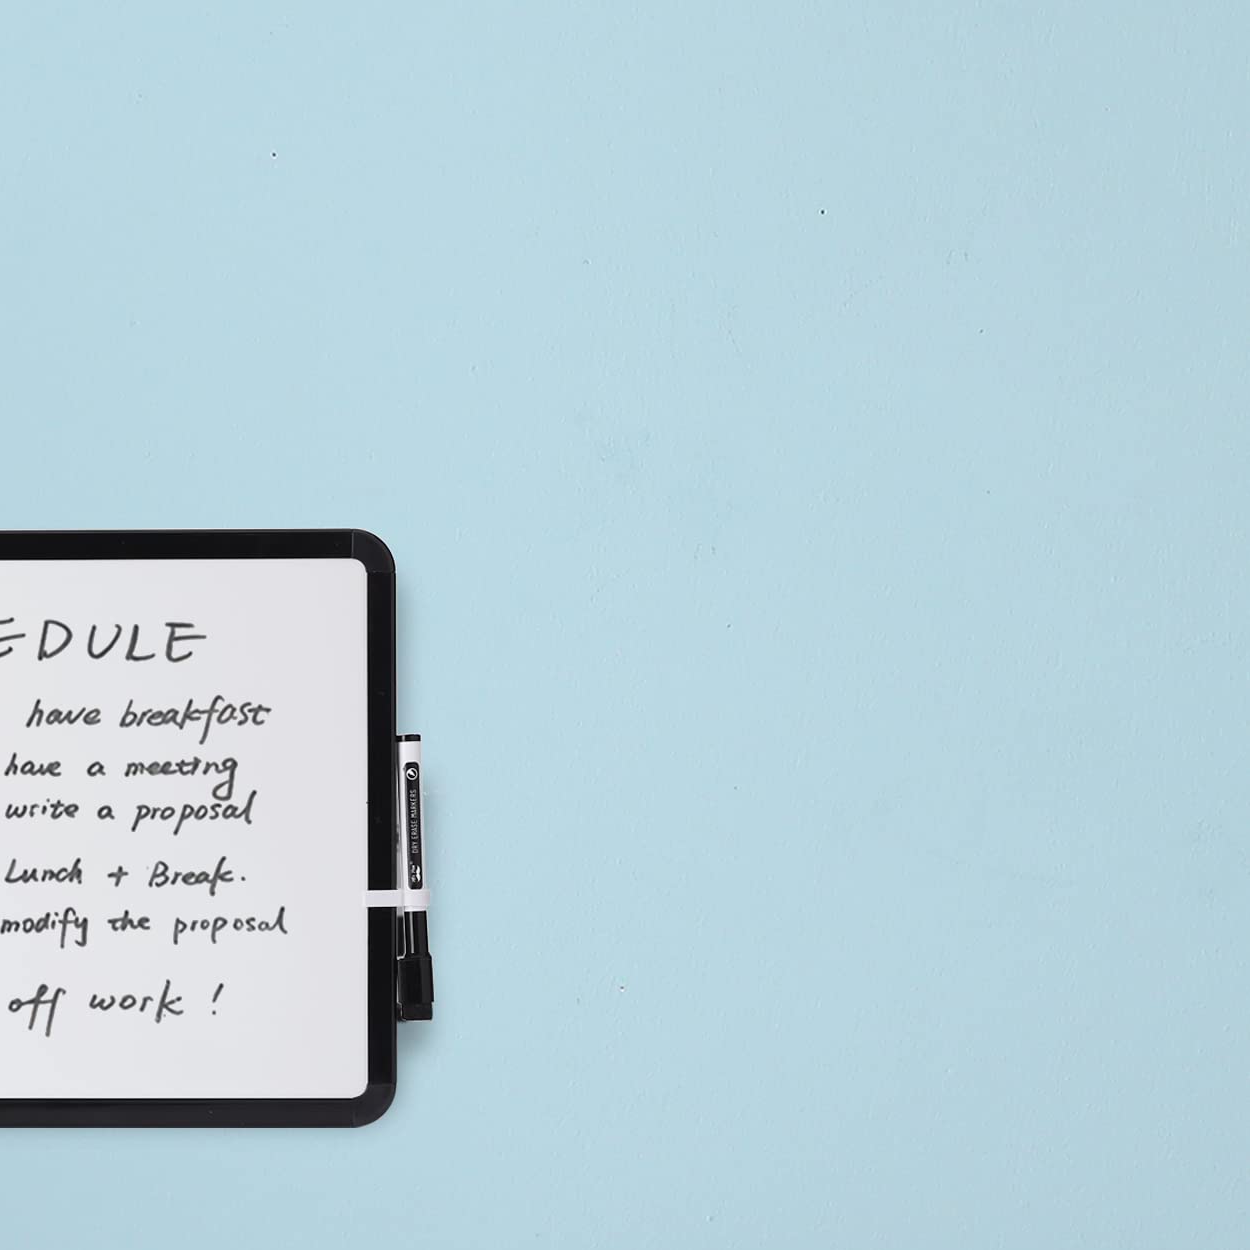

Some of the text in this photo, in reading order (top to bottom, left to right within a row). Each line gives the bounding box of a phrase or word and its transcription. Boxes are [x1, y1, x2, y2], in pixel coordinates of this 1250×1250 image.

[25, 698, 101, 728] have
[119, 694, 272, 745] breakfast
[5, 752, 62, 777] have
[86, 761, 106, 777] a
[124, 756, 239, 802] meeting
[5, 799, 80, 820] write
[97, 805, 115, 820] a
[131, 789, 258, 836] proposal
[409, 789, 417, 818] MARKERS
[410, 819, 418, 840] ERASE
[4, 857, 83, 885] Lunch
[107, 865, 129, 887] +
[0, 906, 89, 949] modify
[107, 909, 151, 932] the
[173, 906, 288, 945] proposal
[8, 983, 67, 1037] off
[89, 979, 184, 1024] work
